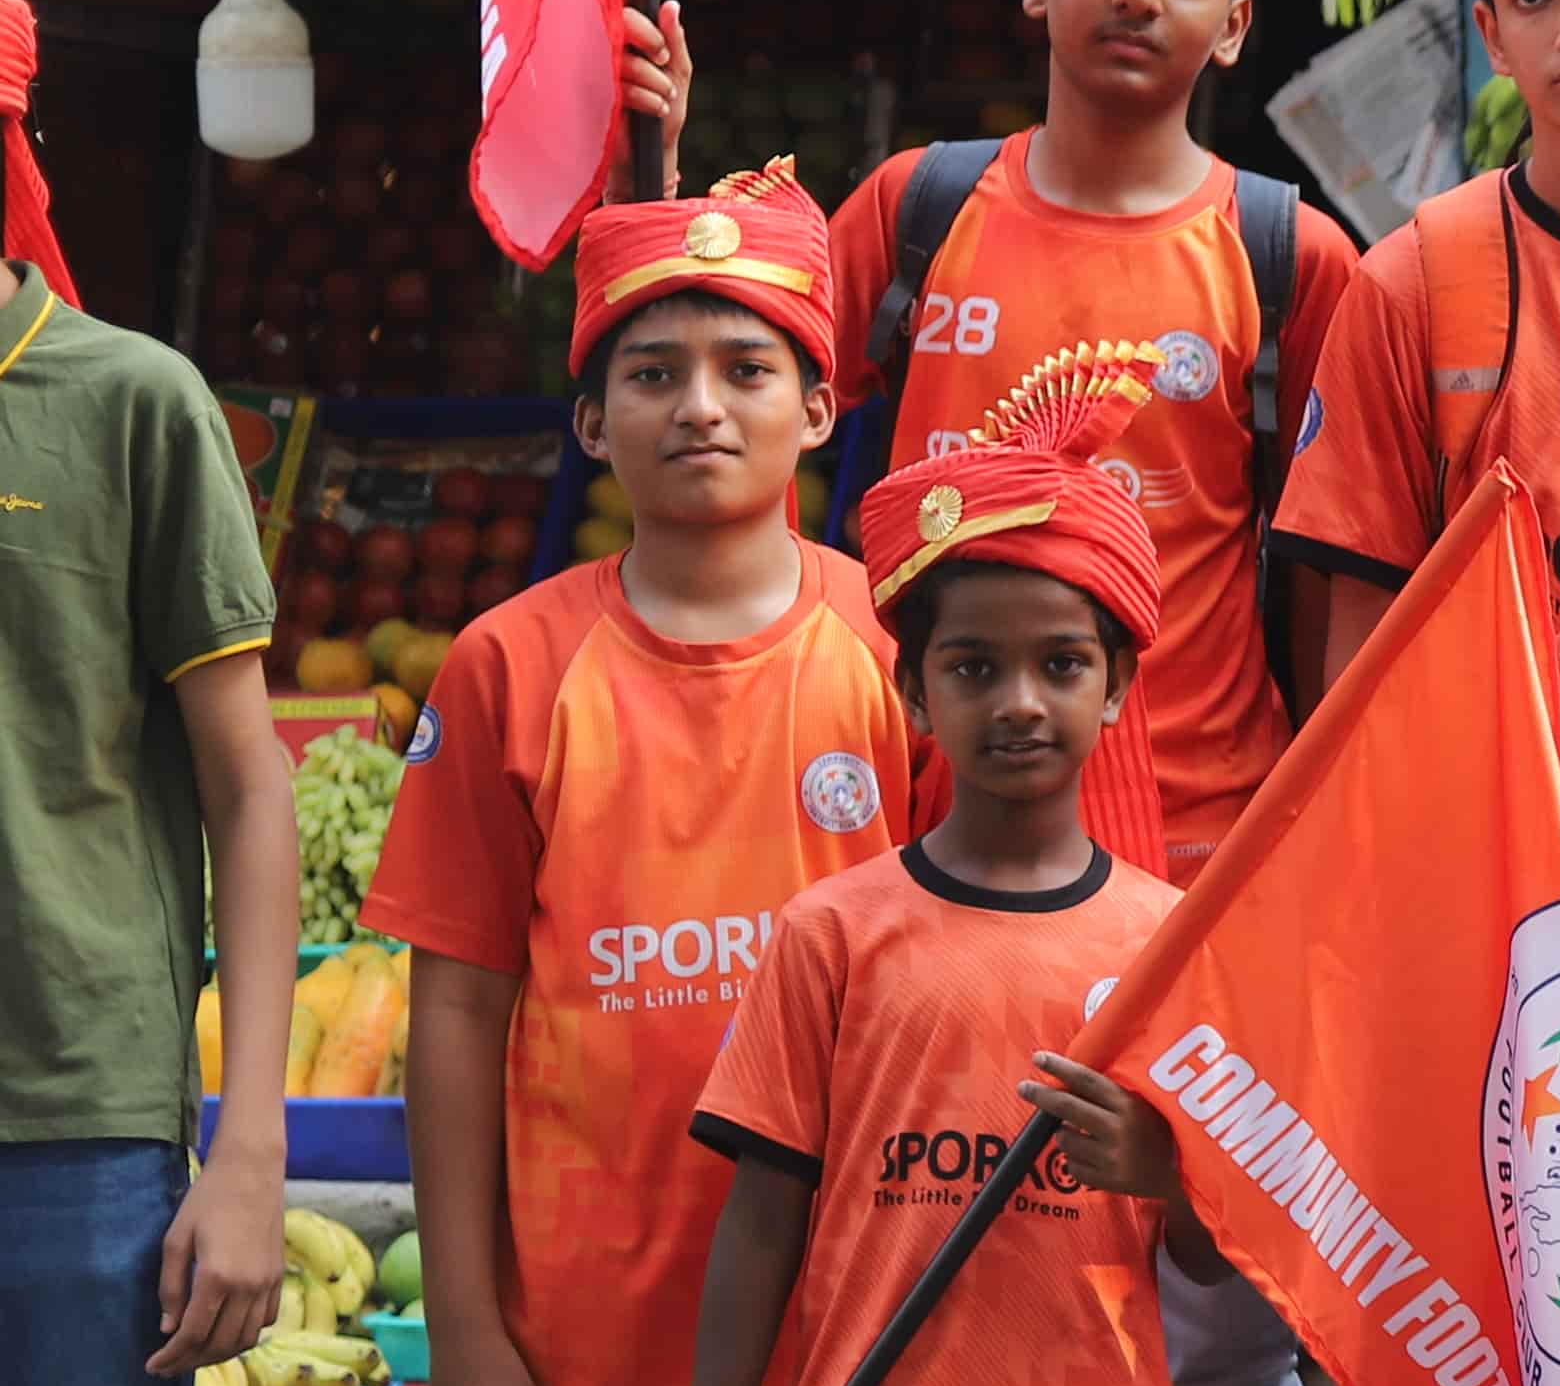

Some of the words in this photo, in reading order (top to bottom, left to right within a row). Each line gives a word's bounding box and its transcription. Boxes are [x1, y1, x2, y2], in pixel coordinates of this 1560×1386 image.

[914, 293, 1000, 356] 28
[588, 910, 773, 989] SPOR
[599, 993, 636, 1014] The
[644, 984, 709, 1008] Little
[719, 980, 746, 999] Bi
[1149, 1023, 1429, 1309] COMMUNITY
[910, 1187, 963, 1207] Little
[1013, 1195, 1081, 1221] Dream
